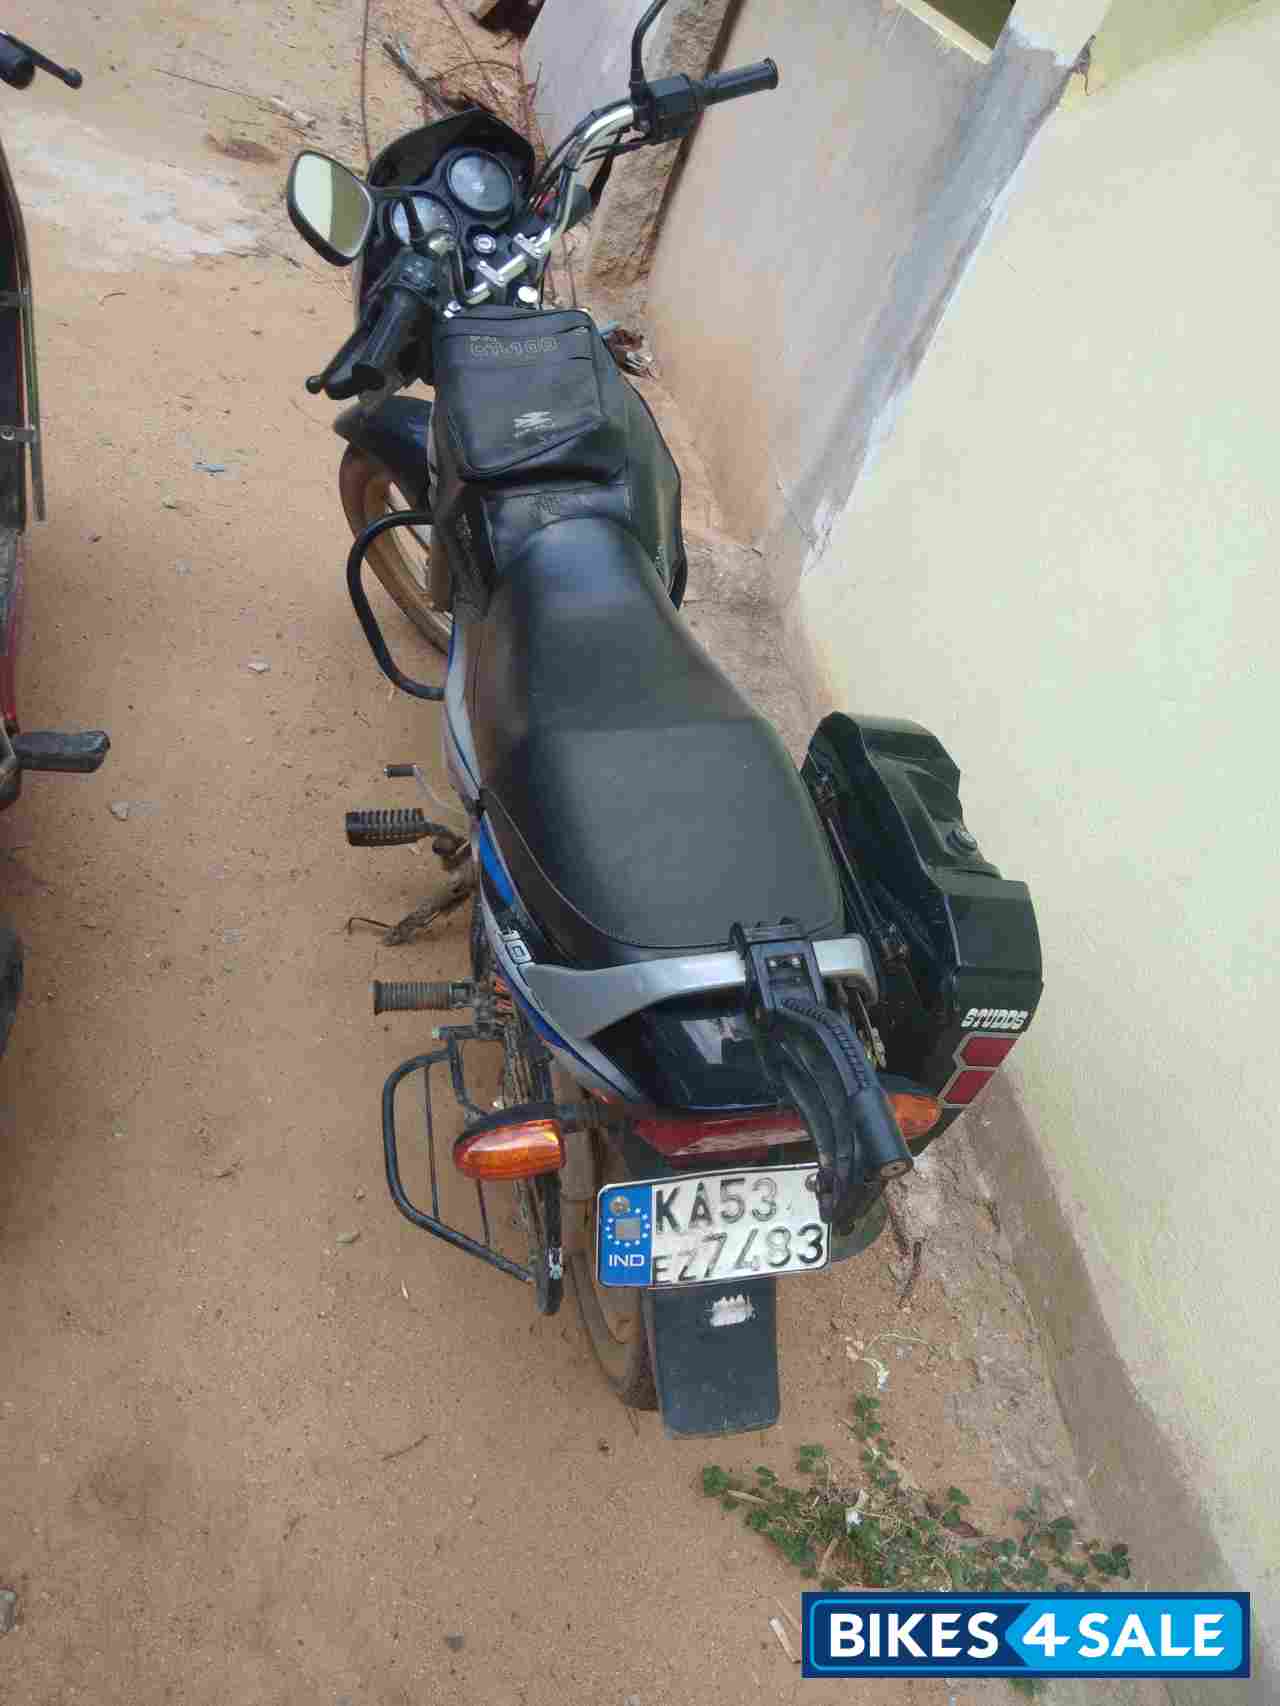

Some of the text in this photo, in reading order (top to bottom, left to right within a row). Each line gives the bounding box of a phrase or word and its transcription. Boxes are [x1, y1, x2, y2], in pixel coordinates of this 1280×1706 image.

[961, 1008, 1028, 1029] STUDDS
[655, 1177, 778, 1233] KA53
[608, 1254, 645, 1267] IND
